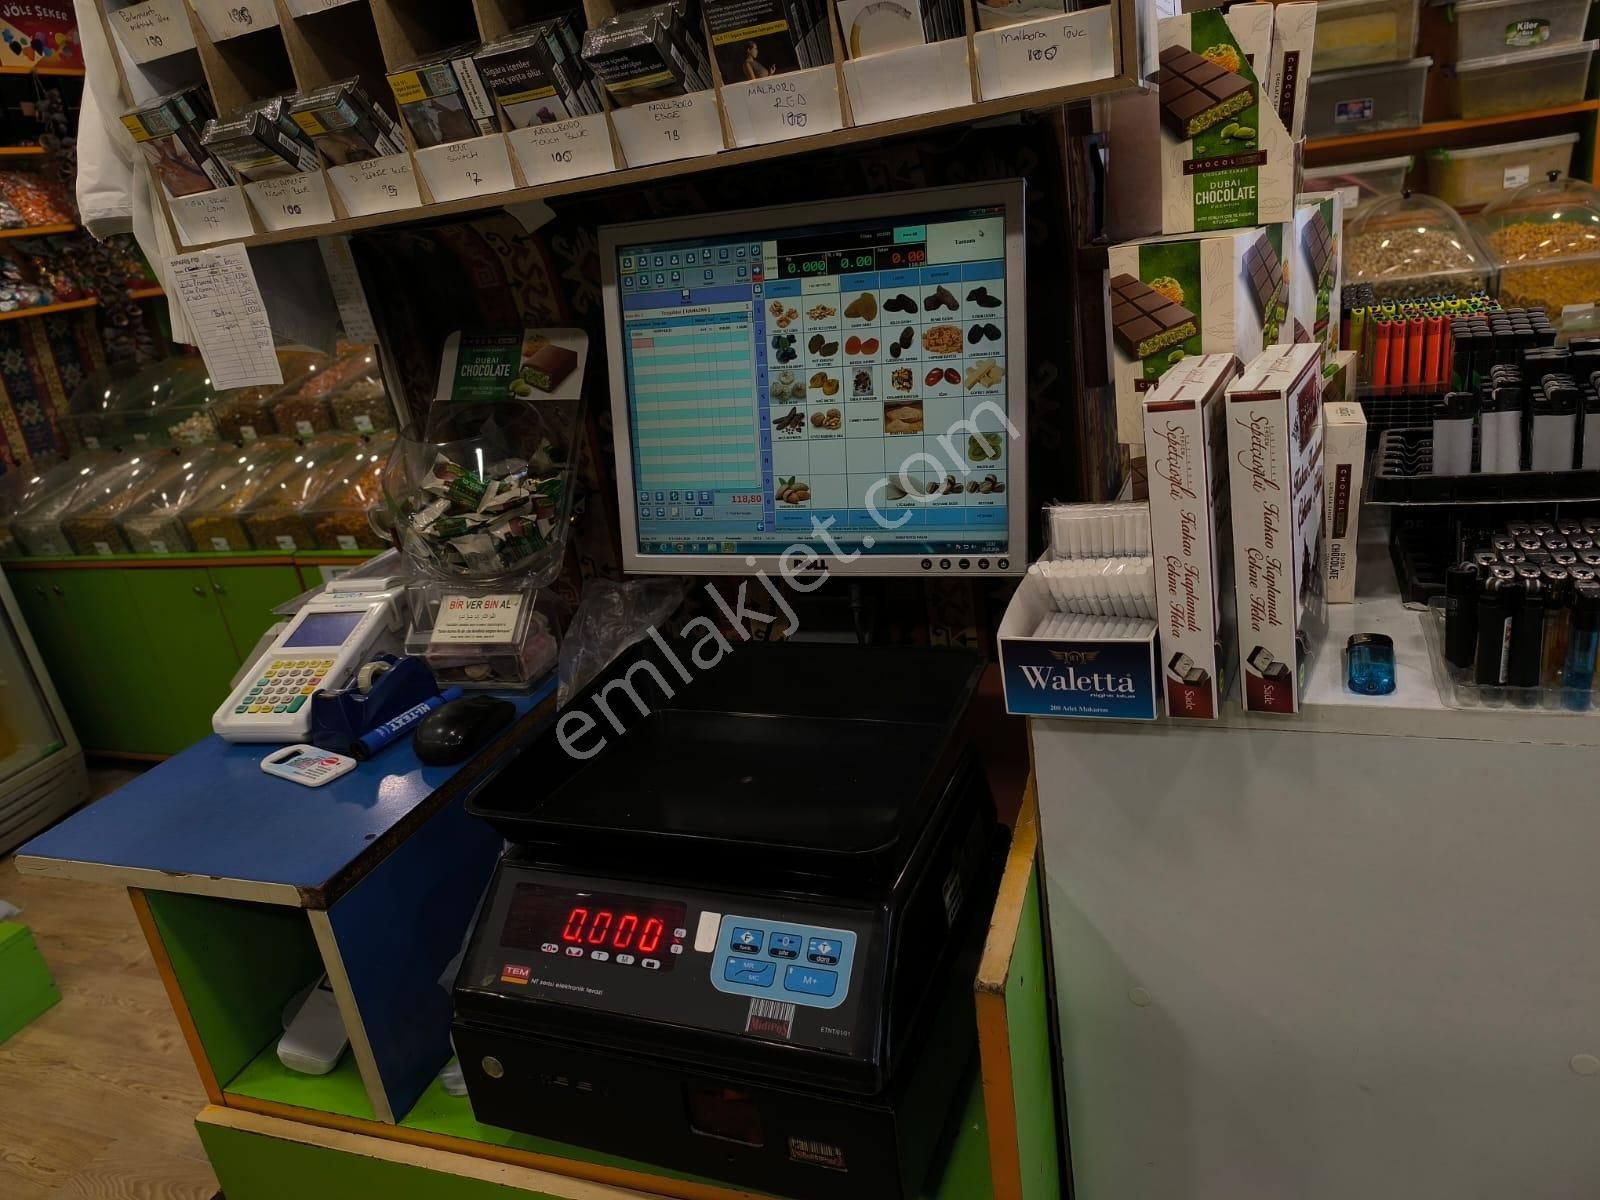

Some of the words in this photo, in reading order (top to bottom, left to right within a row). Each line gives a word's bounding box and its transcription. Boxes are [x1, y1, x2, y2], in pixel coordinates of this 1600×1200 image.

[3, 2, 33, 17] JÖLE
[1210, 179, 1241, 190] DUBAI
[1195, 186, 1256, 205] CHOCOLATE
[840, 255, 873, 269] 0.00
[891, 249, 925, 264] 0.00
[461, 364, 512, 377] CHOCOLATE
[1181, 509, 1197, 556] Kakao
[1263, 500, 1281, 550] Kakao
[1329, 543, 1341, 580] CHOCOLATE
[1181, 562, 1202, 633] Kaplamalı
[1262, 555, 1283, 627] Kaplamalı
[466, 600, 482, 610] VER
[499, 600, 512, 609] AL
[1250, 593, 1266, 632] Helva
[1170, 600, 1185, 639] Helva
[1184, 689, 1195, 710] Sade
[1263, 684, 1274, 704] Sade
[563, 908, 664, 952] 0.000
[506, 966, 529, 977] TEM
[803, 975, 817, 985] M+
